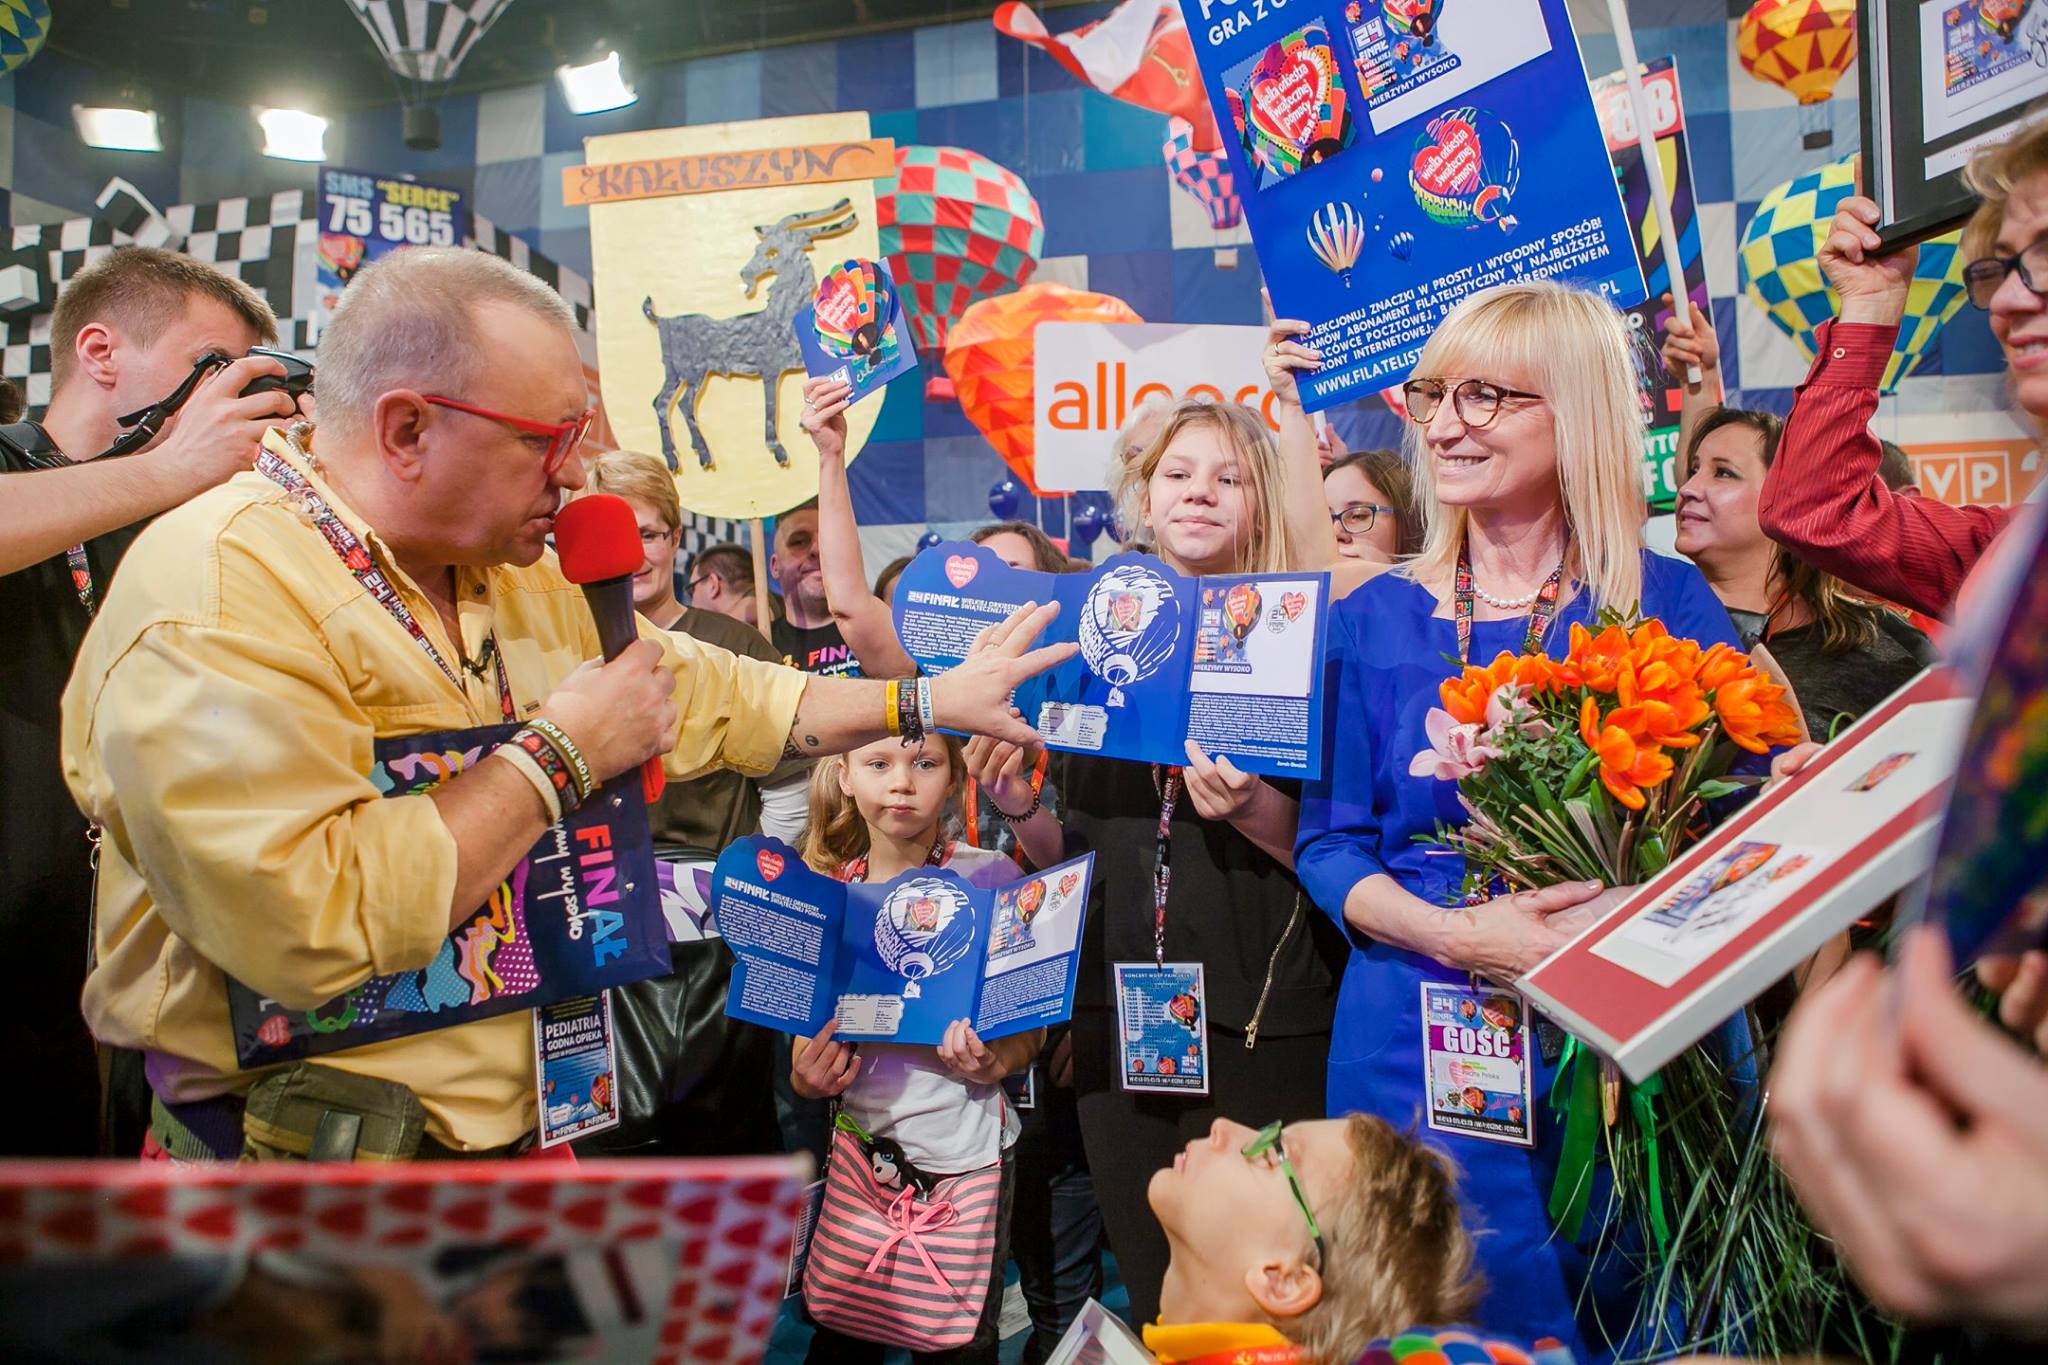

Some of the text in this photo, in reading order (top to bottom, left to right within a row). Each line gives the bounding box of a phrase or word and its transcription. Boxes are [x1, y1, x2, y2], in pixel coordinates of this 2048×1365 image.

[1208, 10, 1252, 46] GRA
[1354, 19, 1383, 48] 24
[1369, 58, 1457, 108] MIERZYMY WYSOKO
[325, 171, 374, 199] SMS
[583, 144, 876, 198] KAŁUSZYN
[325, 194, 455, 247] 75 565
[1369, 289, 1415, 315] ZNACZKI
[1418, 283, 1428, 295] W
[1432, 266, 1473, 290] PROSTY
[1477, 263, 1483, 273] I
[1486, 238, 1546, 270] WYGODNY
[1551, 217, 1602, 245] SPOSÓB!
[1347, 304, 1410, 337] ABONAMENT
[1416, 268, 1505, 310] FILATELISTYCZNY
[1512, 261, 1523, 274] W
[1529, 230, 1605, 268] NAJBLIŻSZEJ
[1353, 323, 1434, 360] INTERNETOWEJ:
[1366, 310, 1436, 342] POCZTOWEJ,
[259, 449, 276, 473] 24
[329, 516, 357, 547] FINAŁ
[362, 571, 415, 627] 24 FINAŁ
[923, 592, 960, 609] FINAŁ
[1223, 664, 1251, 674] WYSOKO
[537, 866, 601, 940] wysoko
[576, 824, 628, 968] FINAŁ
[737, 881, 769, 901] FINAŁ
[1432, 996, 1454, 1010] 24
[546, 1014, 602, 1039] PEDIATRIA
[547, 1036, 575, 1051] GODNA
[575, 1029, 603, 1045] OPIEKA
[1443, 1025, 1510, 1058] GOŚĆ
